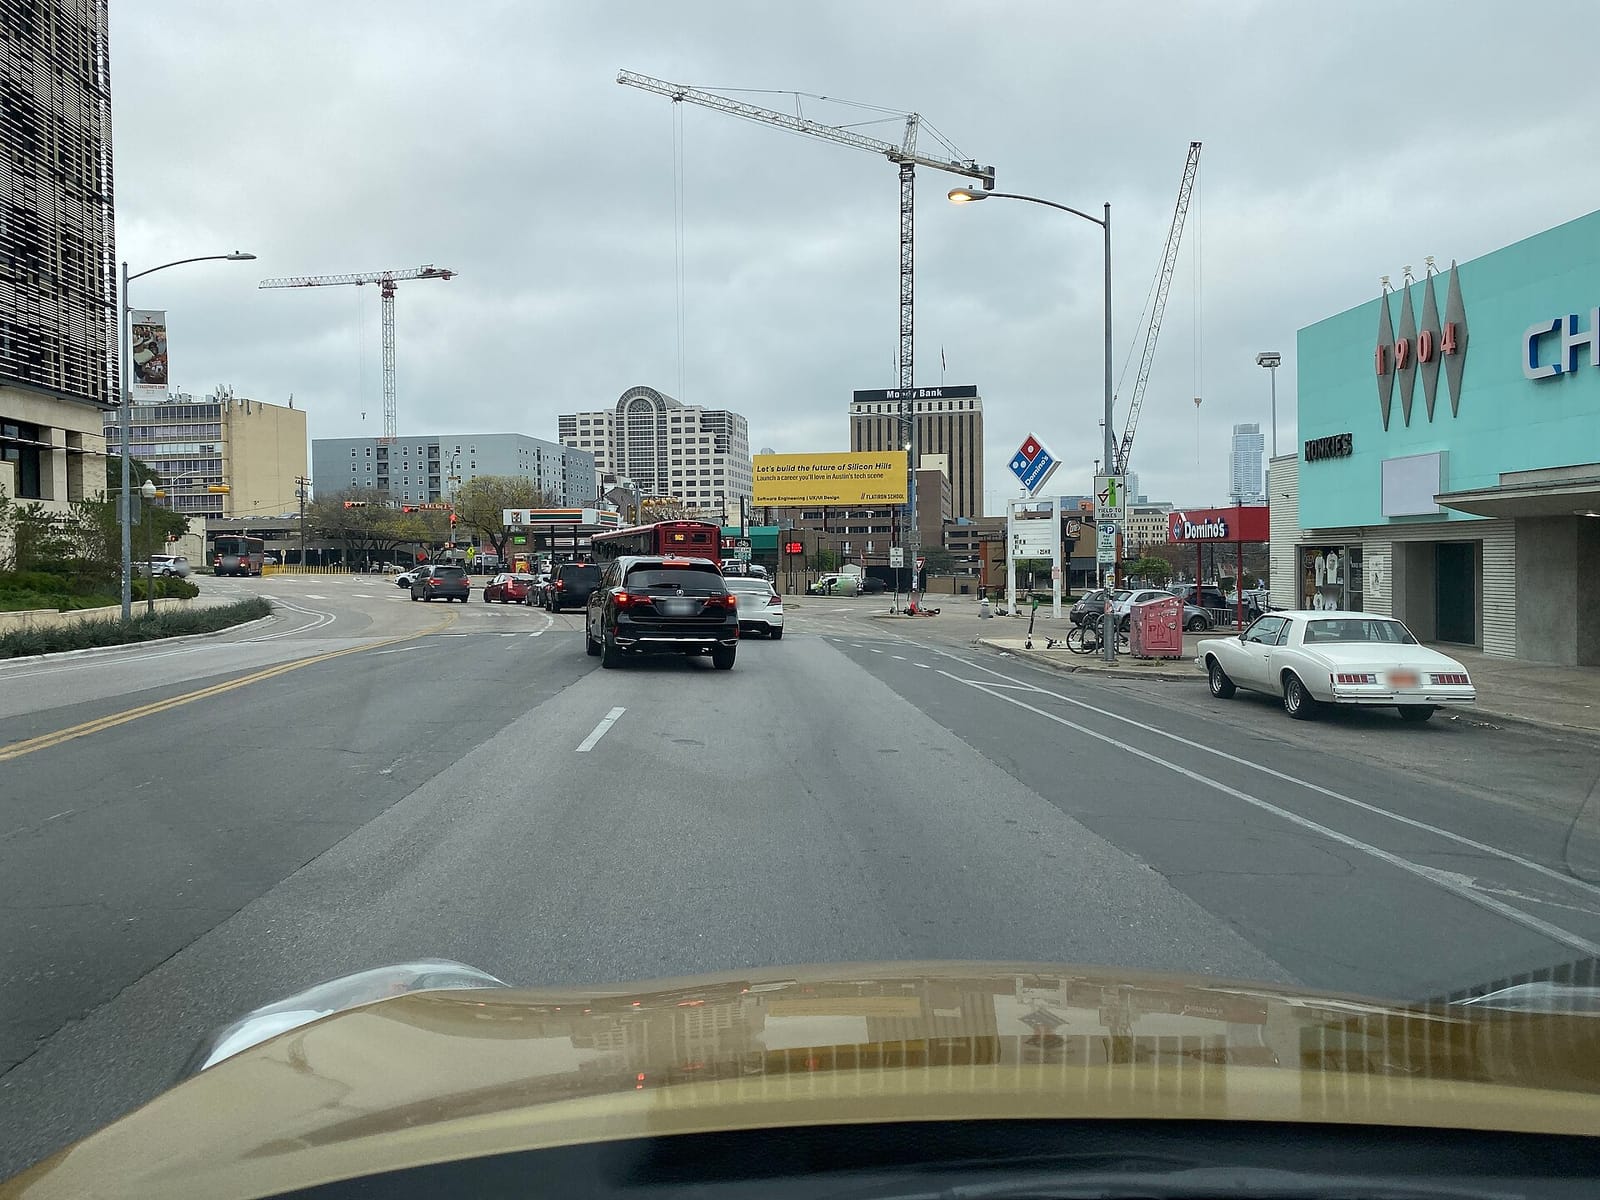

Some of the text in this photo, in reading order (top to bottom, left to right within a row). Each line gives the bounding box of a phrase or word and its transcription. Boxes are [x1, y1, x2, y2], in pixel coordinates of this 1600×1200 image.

[1375, 321, 1457, 377] 1904
[1522, 306, 1600, 380] CH
[886, 388, 942, 399] Moy Bank
[756, 465, 774, 473] Let's
[776, 464, 796, 472] build
[798, 464, 810, 472] the
[874, 462, 892, 470] Hills
[1024, 455, 1049, 486] Domino's
[1184, 517, 1225, 539] Domino's
